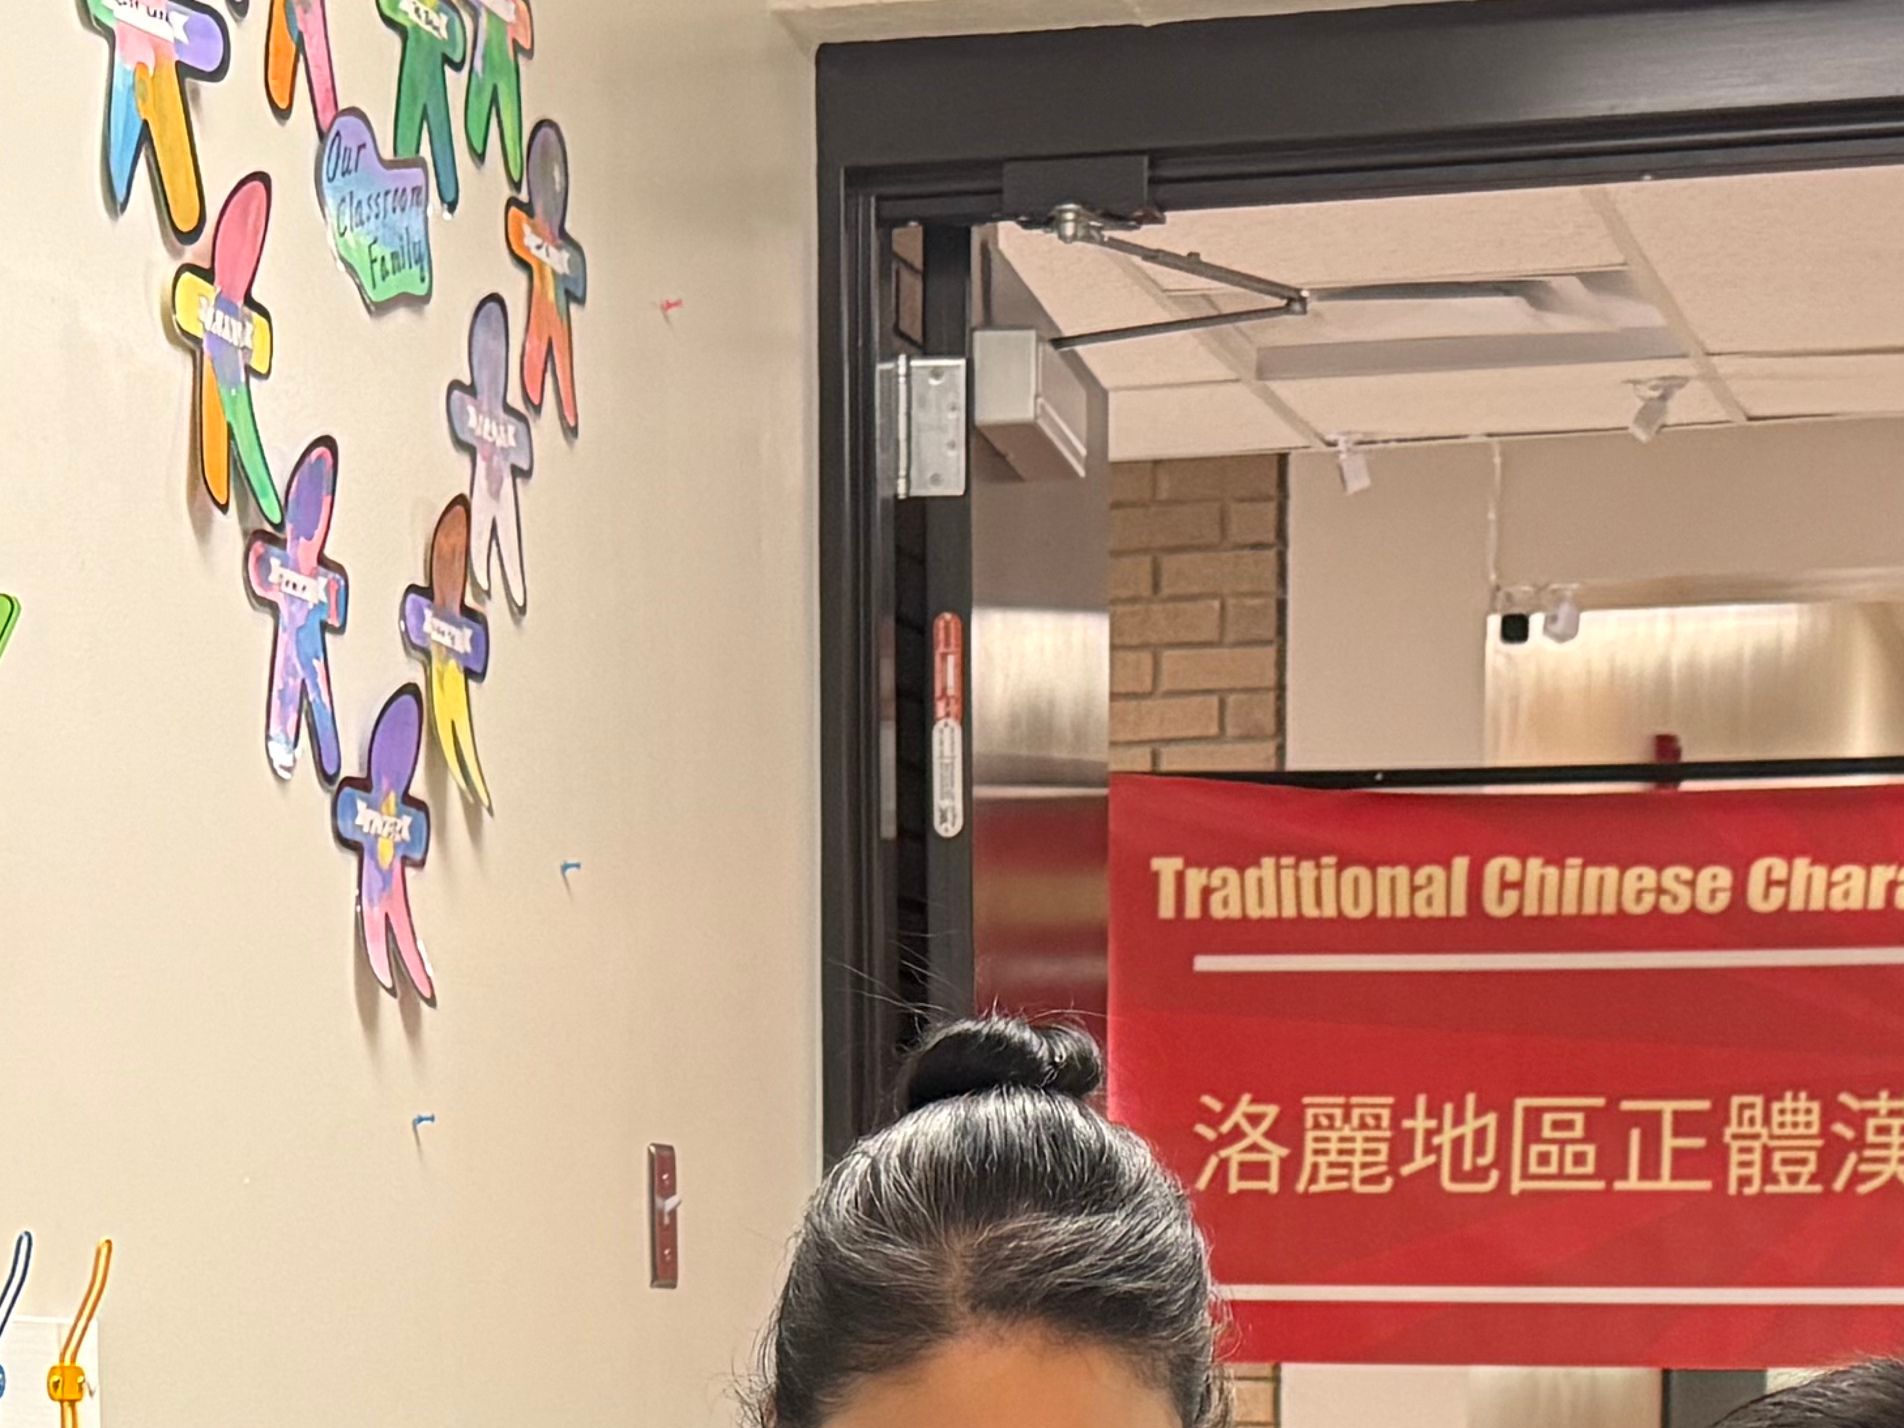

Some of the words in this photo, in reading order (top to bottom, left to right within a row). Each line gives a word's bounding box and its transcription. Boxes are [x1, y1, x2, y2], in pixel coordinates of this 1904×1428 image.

[326, 129, 366, 183] Our
[336, 185, 425, 238] Classroom
[367, 227, 426, 291] Family
[1150, 855, 1470, 920] Traditional
[1482, 855, 1732, 916] Chinese
